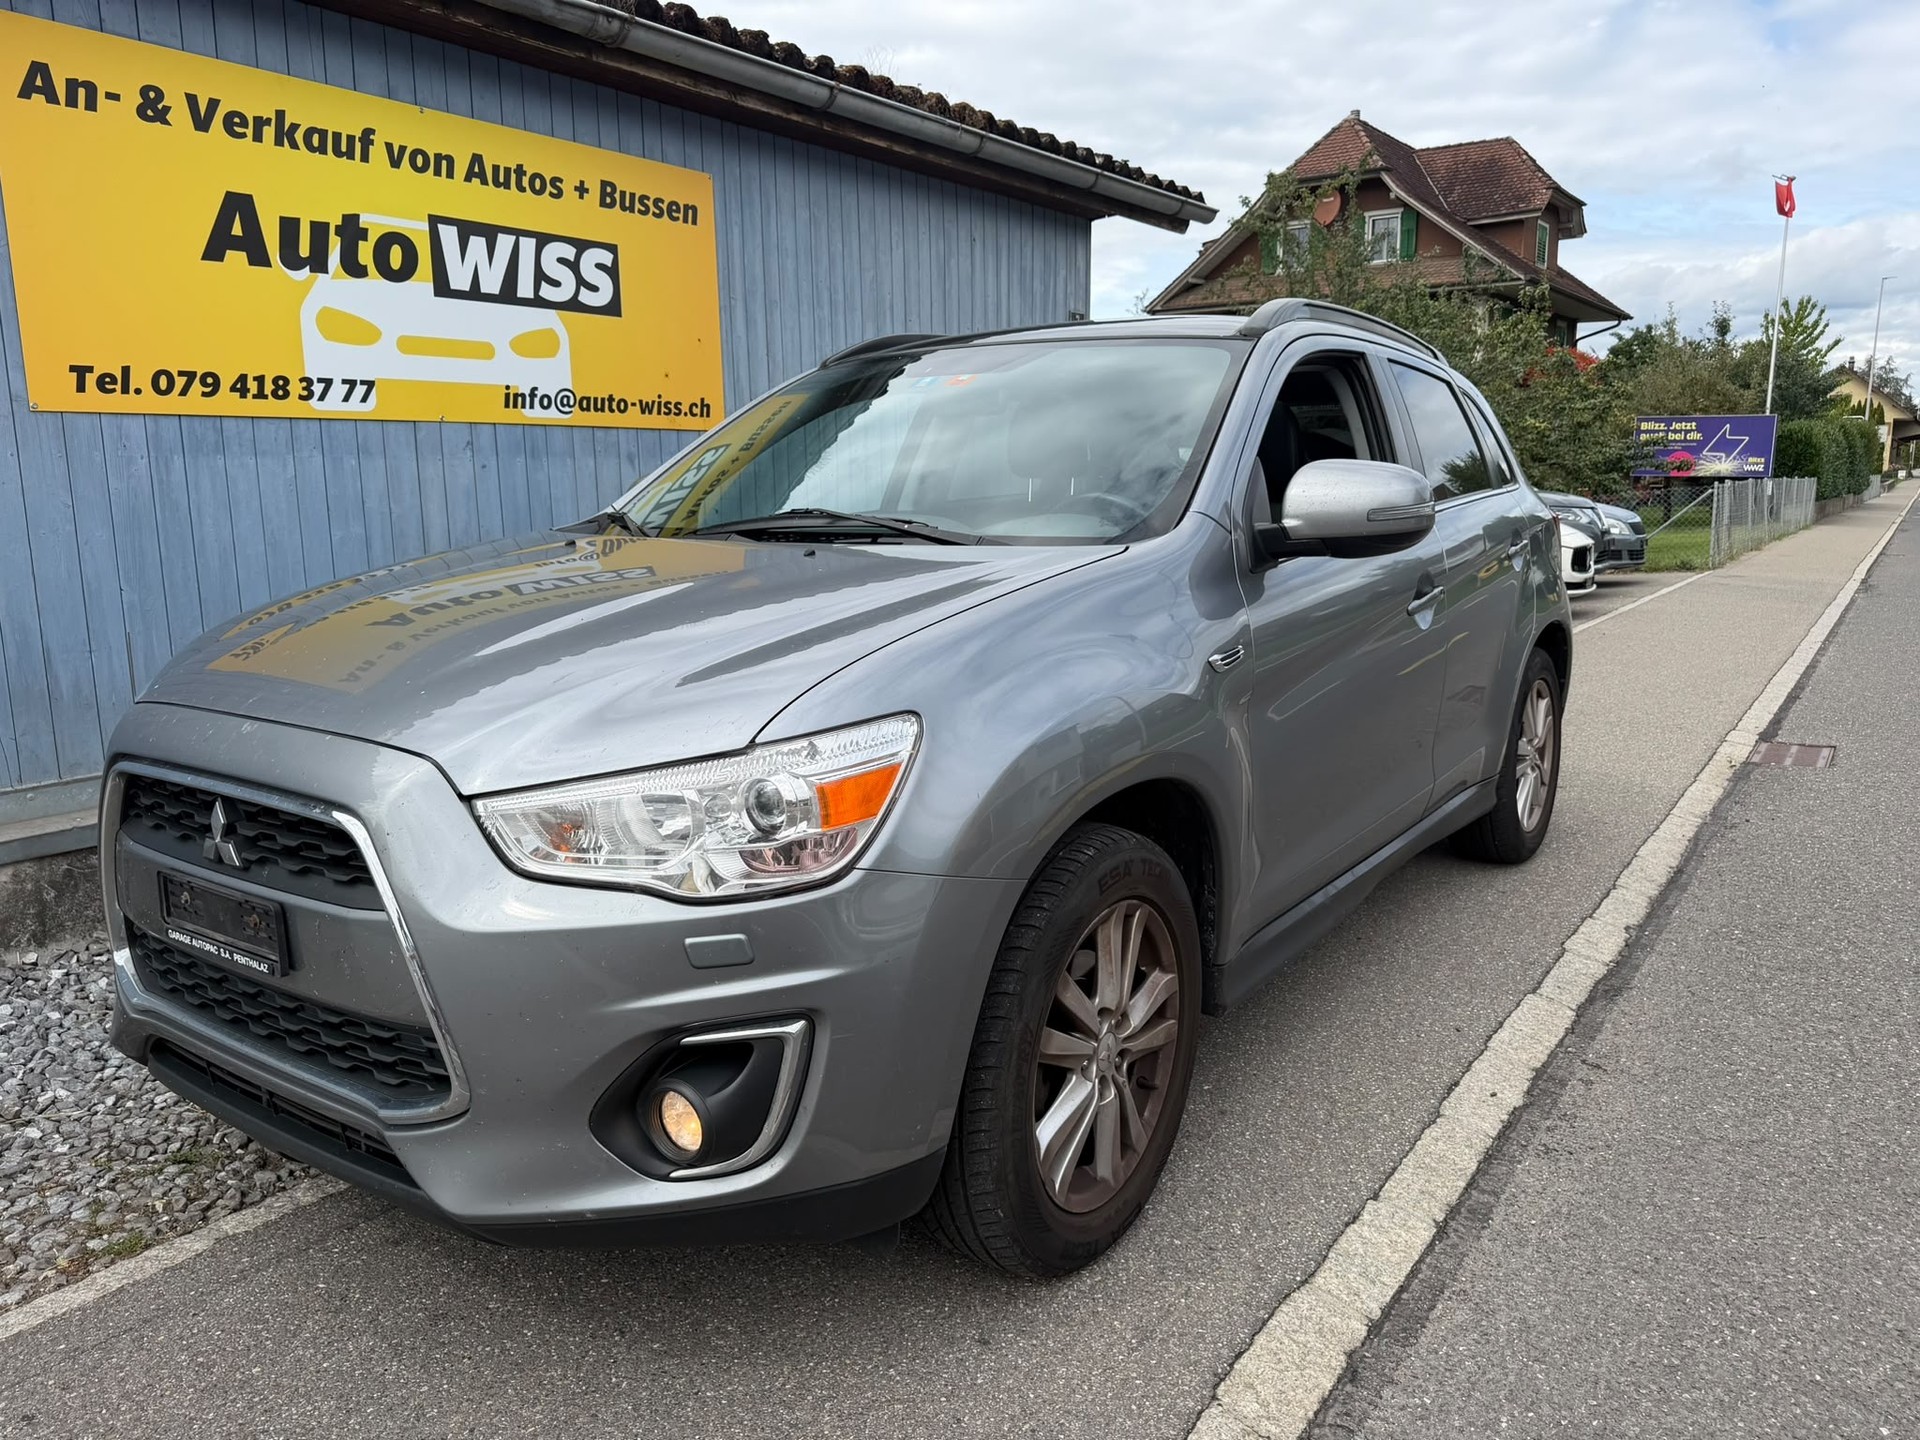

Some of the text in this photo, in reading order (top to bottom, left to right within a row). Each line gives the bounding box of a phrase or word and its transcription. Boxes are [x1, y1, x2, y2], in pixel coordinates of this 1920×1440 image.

[16, 60, 699, 226] An- & Verkauf von Autos + Bussen
[200, 190, 615, 307] Auto WISS
[68, 364, 376, 404] Tel. 079 418 37 77
[504, 384, 711, 419] info@auto-wiss.ch
[1640, 421, 1697, 430] Blizz. Jetzt
[1667, 431, 1684, 440] bei
[1686, 431, 1704, 440] dir.
[168, 929, 269, 973] GARAGE AUTOPAC S.A. PENTHALAZ
